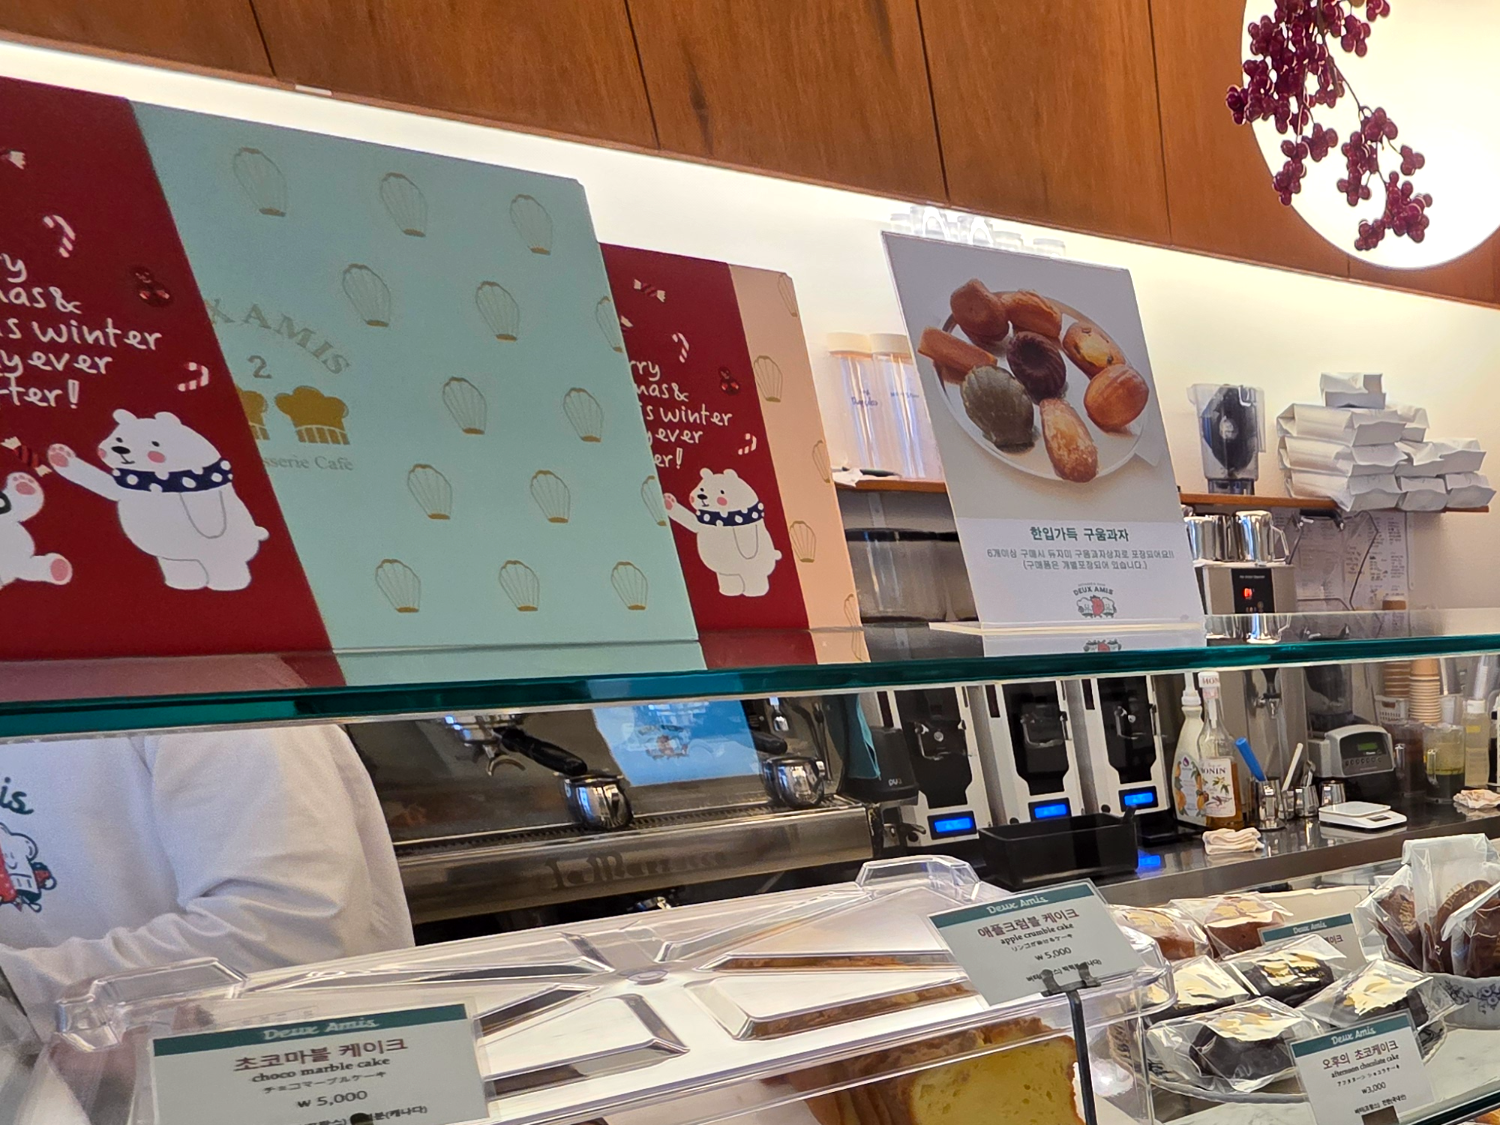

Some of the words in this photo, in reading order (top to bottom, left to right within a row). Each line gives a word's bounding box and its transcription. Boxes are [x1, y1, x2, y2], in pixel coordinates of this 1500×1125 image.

[0, 253, 28, 284] y
[0, 318, 22, 339] s
[31, 317, 162, 350] winter
[241, 303, 351, 376] AMIS
[27, 351, 113, 375] ever
[247, 355, 272, 379] 2
[660, 403, 733, 426] winter
[655, 427, 703, 444] ever
[1030, 526, 1078, 541] 한입가득
[1083, 527, 1129, 542] 구움과자
[986, 548, 1017, 559] 6개이상
[1020, 548, 1046, 559] 구매시
[1074, 549, 1129, 560] 구움과자상자로
[1073, 585, 1093, 597] DEUX
[1094, 585, 1114, 596] AMIS
[986, 902, 1019, 915] Deux
[1019, 895, 1049, 908] Amis
[977, 915, 1042, 939] 애플크럼블
[1043, 908, 1080, 925] 케이크
[1000, 932, 1023, 946] apple
[1024, 925, 1056, 940] crumble
[1056, 921, 1074, 933] cake
[1046, 946, 1072, 960] 5,000
[263, 1024, 320, 1041] Deux
[324, 1017, 382, 1033] Amis
[1331, 1033, 1354, 1046] Deux
[1355, 1025, 1377, 1040] Amis
[233, 1046, 332, 1073] 초코마블
[338, 1037, 409, 1058] 케이크
[1322, 1051, 1351, 1071] 오후의
[1354, 1040, 1399, 1061] 초코케이크
[1331, 1064, 1359, 1079] afternoon
[1360, 1056, 1387, 1071] chocolate
[1387, 1053, 1399, 1063] cake
[251, 1068, 299, 1084] choco
[300, 1061, 354, 1077] marble
[357, 1056, 391, 1070] cake
[316, 1089, 369, 1108] 5,000
